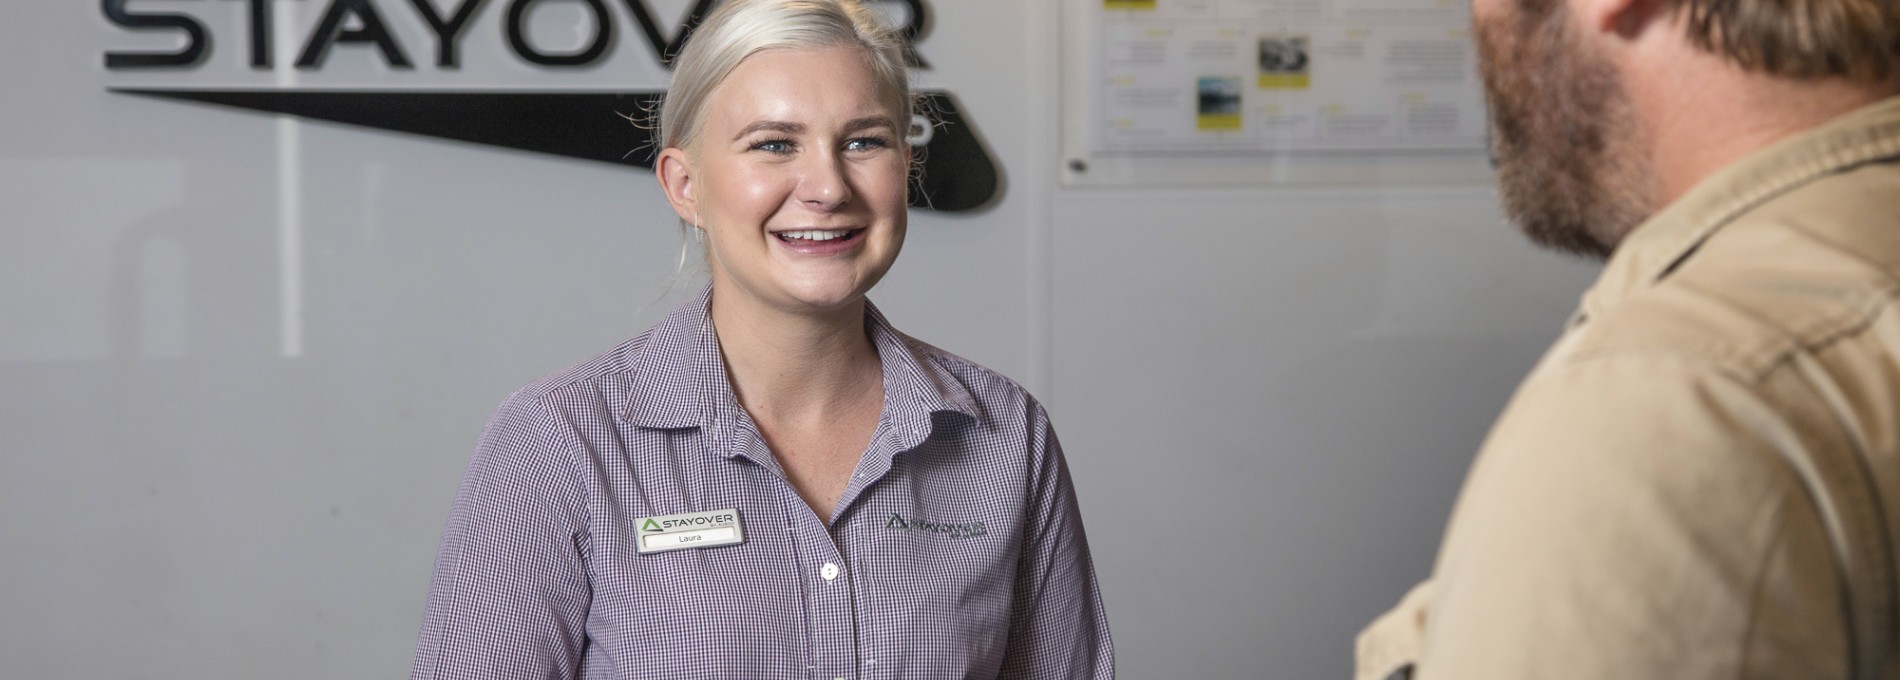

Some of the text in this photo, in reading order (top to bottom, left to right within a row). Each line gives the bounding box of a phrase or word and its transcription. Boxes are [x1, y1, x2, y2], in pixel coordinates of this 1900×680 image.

[104, 0, 933, 69] STAYOVR
[662, 513, 734, 529] STAYOVER
[678, 534, 702, 543] Laura
